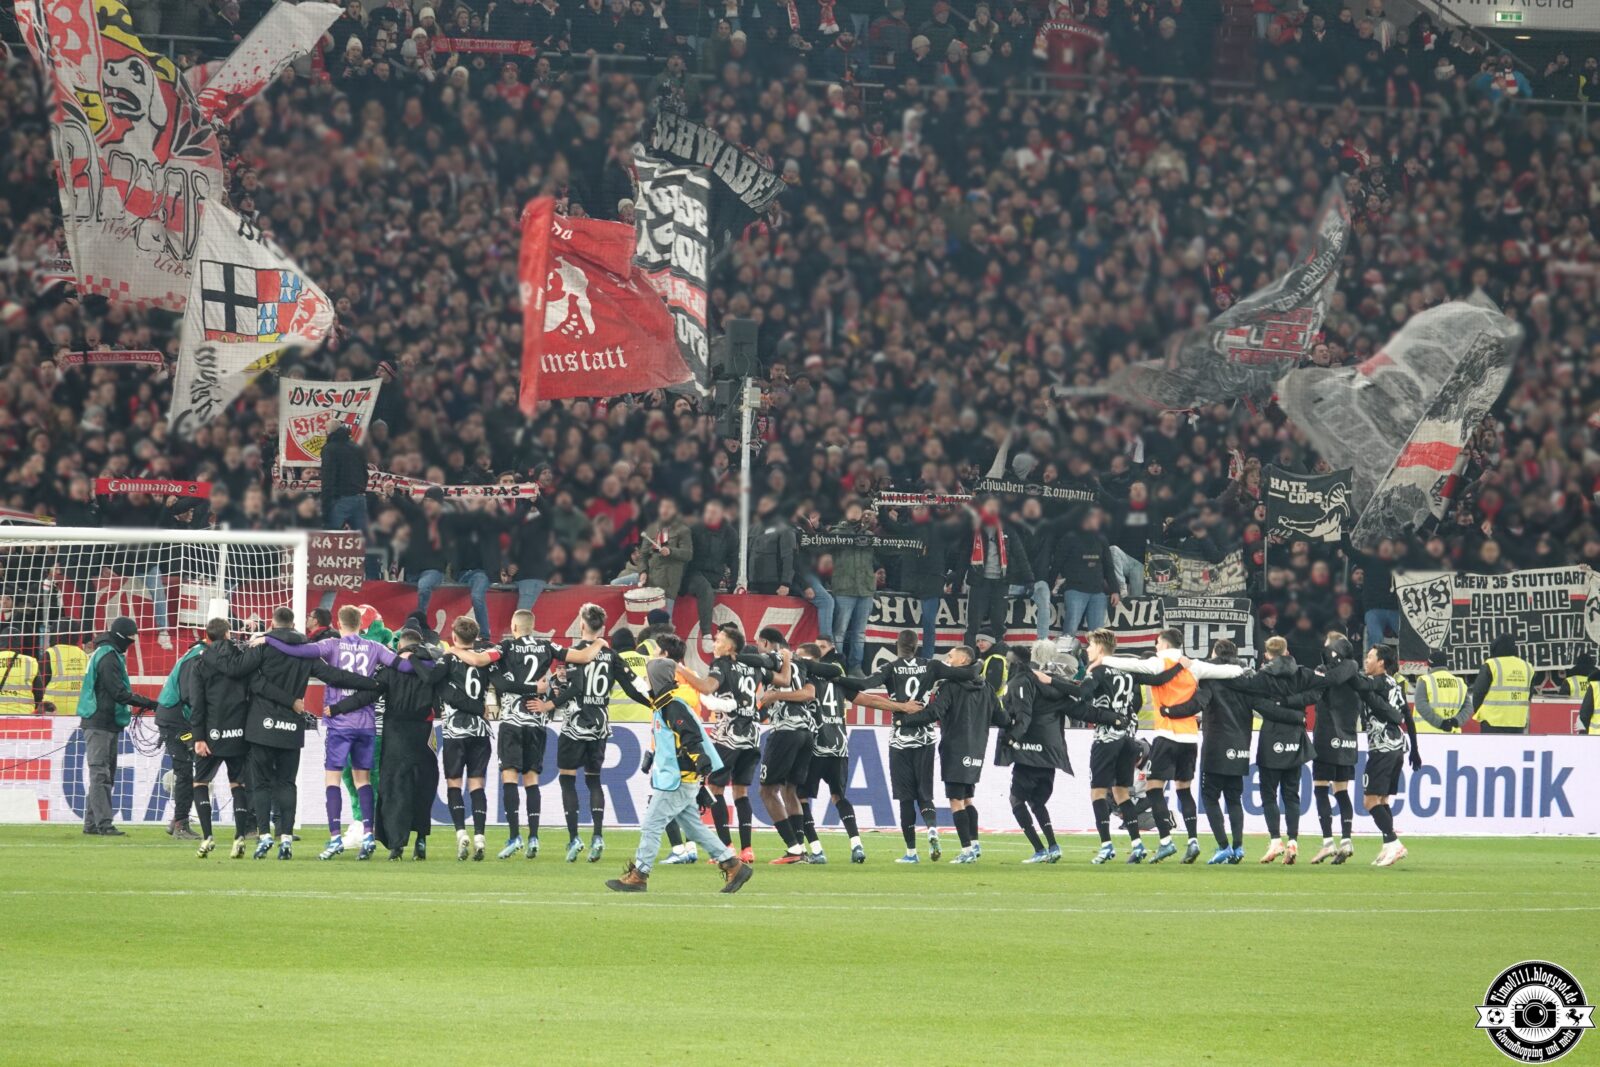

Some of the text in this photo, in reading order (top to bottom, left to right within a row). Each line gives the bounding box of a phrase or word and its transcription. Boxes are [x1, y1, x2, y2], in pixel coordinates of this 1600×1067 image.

[108, 480, 182, 493] Commando
[1270, 477, 1307, 493] HATE
[1288, 491, 1323, 504] COPS
[800, 533, 854, 546] Schwaben
[317, 556, 365, 569] KAMPF
[1454, 572, 1586, 589] CREW 36 STUTTGART
[1178, 597, 1234, 608] EHRE ALLEN
[1165, 610, 1247, 621] VERSTORBENEN ULTRAS
[515, 645, 546, 653] STUTTGART
[523, 654, 539, 686] 2
[897, 666, 927, 675] STUTTGART
[465, 666, 481, 699] 6
[584, 661, 609, 697] 16
[905, 676, 920, 701] 9
[823, 682, 838, 717] 4
[274, 720, 297, 731] JAKO
[221, 728, 244, 739] JAKO
[1022, 743, 1043, 751] JAKO
